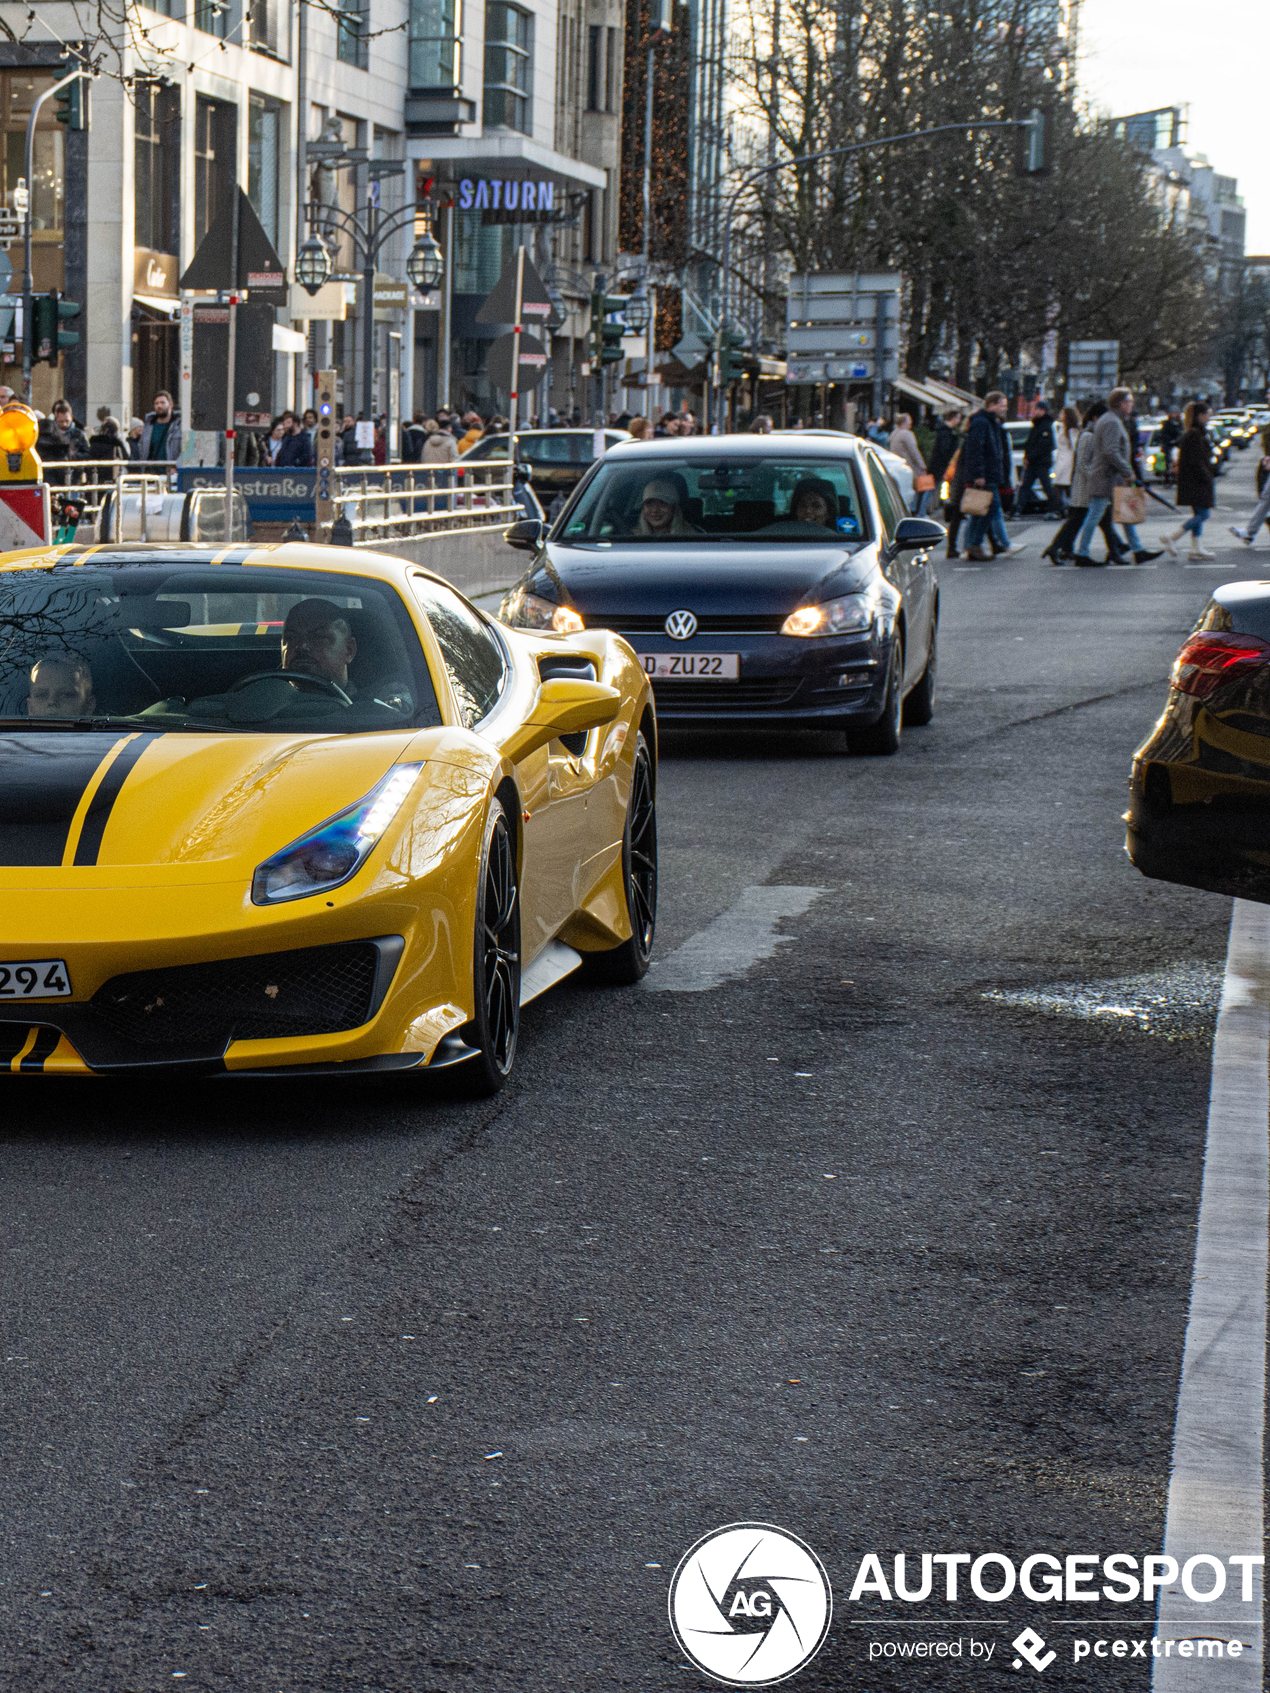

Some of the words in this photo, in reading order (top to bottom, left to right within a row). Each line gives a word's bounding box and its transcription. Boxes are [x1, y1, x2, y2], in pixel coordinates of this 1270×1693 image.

[459, 179, 554, 211] SATURN
[644, 657, 656, 674] D
[670, 657, 694, 675] ZU
[698, 657, 722, 675] 22
